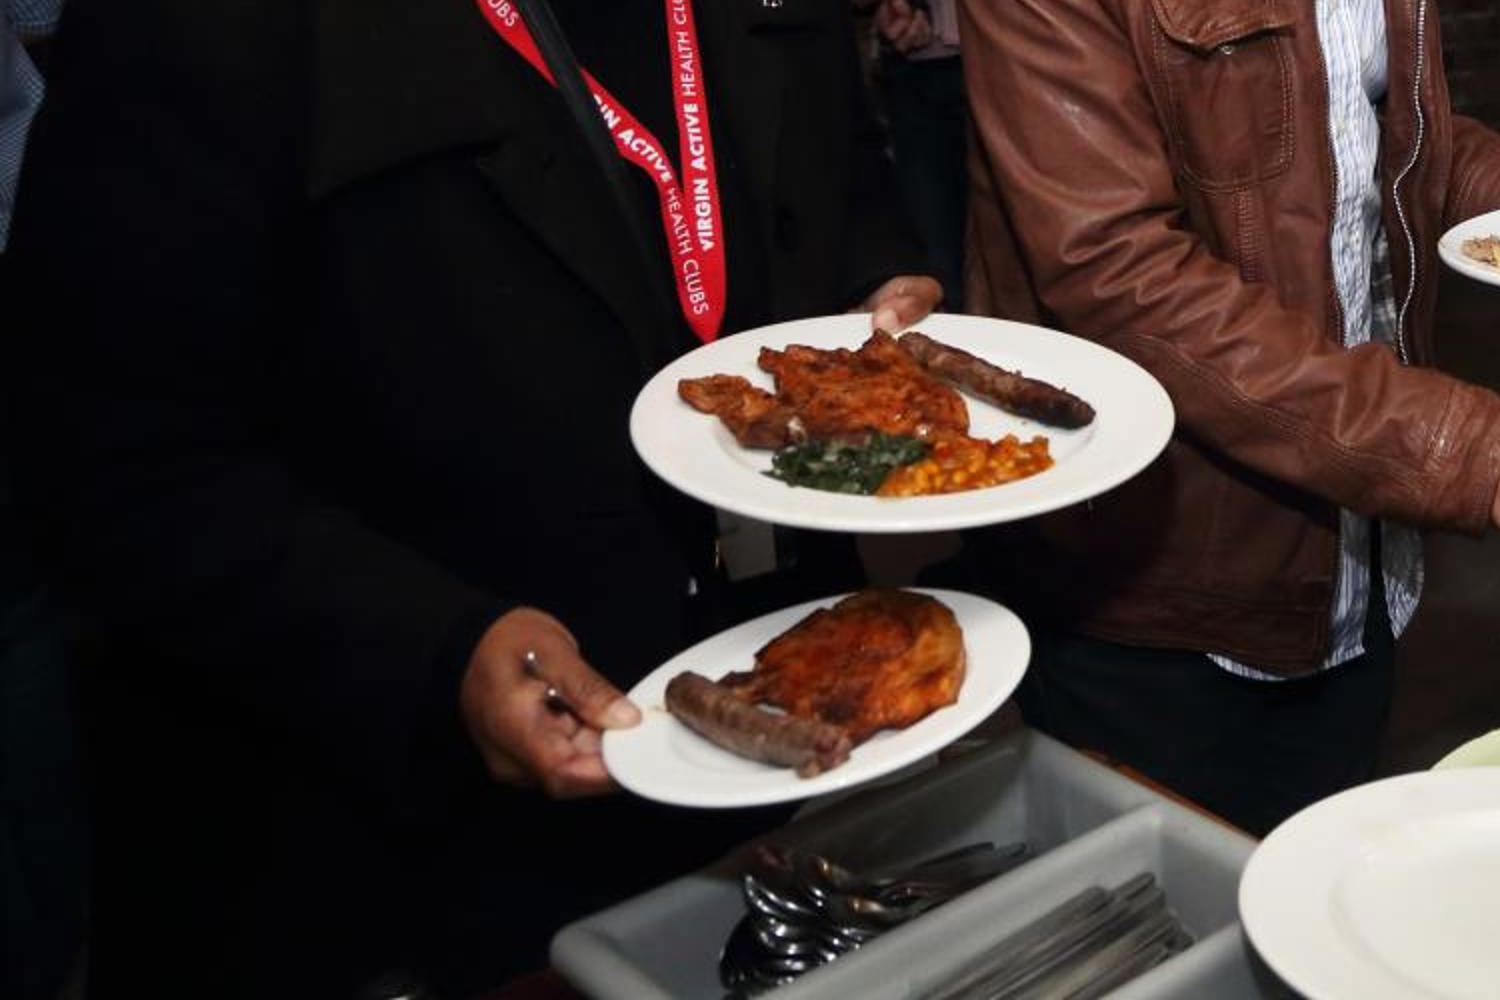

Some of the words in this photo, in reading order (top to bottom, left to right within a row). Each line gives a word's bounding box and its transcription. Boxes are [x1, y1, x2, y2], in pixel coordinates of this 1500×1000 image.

[676, 31, 697, 97] HEALTH
[684, 103, 709, 171] ACTIVE
[618, 128, 673, 183] ACTIVE
[666, 187, 693, 256] HEALTH
[682, 259, 709, 315] CLUBS
[693, 178, 715, 251] VIRGIN
